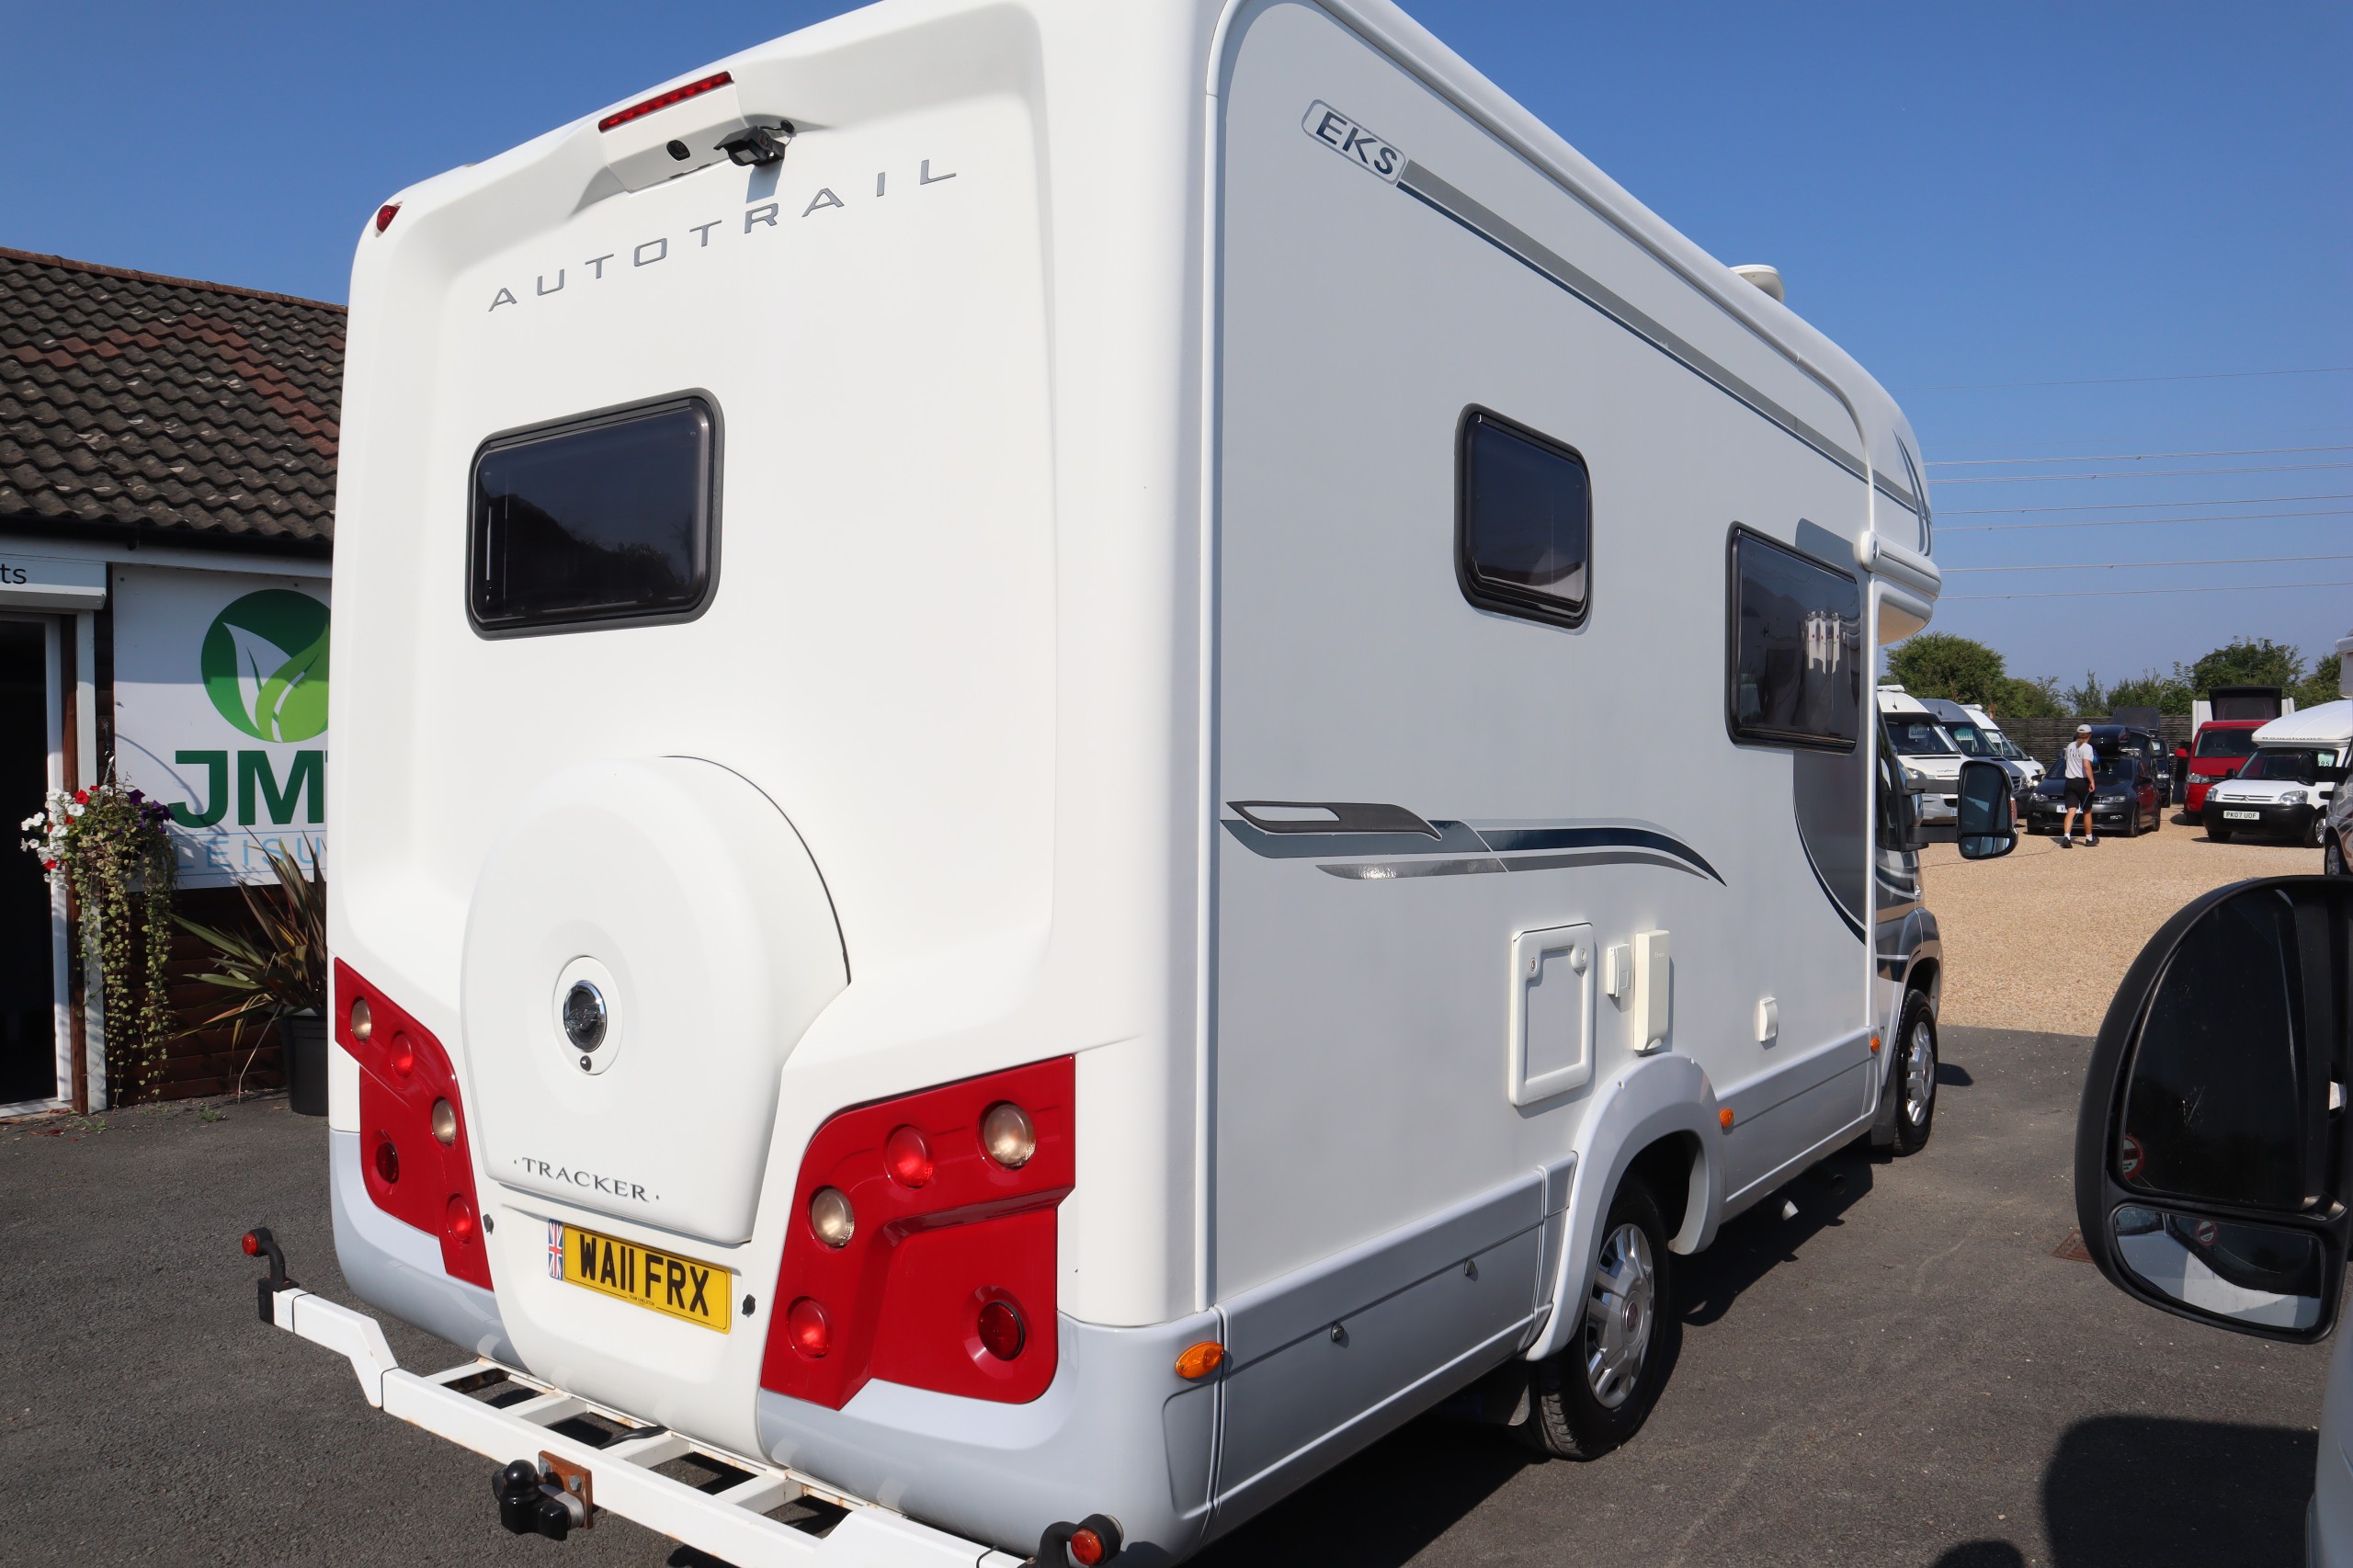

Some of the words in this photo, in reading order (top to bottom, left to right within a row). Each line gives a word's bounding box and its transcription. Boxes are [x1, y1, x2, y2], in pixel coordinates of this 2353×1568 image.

[1315, 110, 1398, 175] EKS
[488, 159, 957, 312] AUTOTRAIL
[167, 749, 328, 828] JM
[522, 1157, 649, 1202] TRACKER
[579, 1233, 635, 1293] WA11
[644, 1253, 709, 1317] FRX
